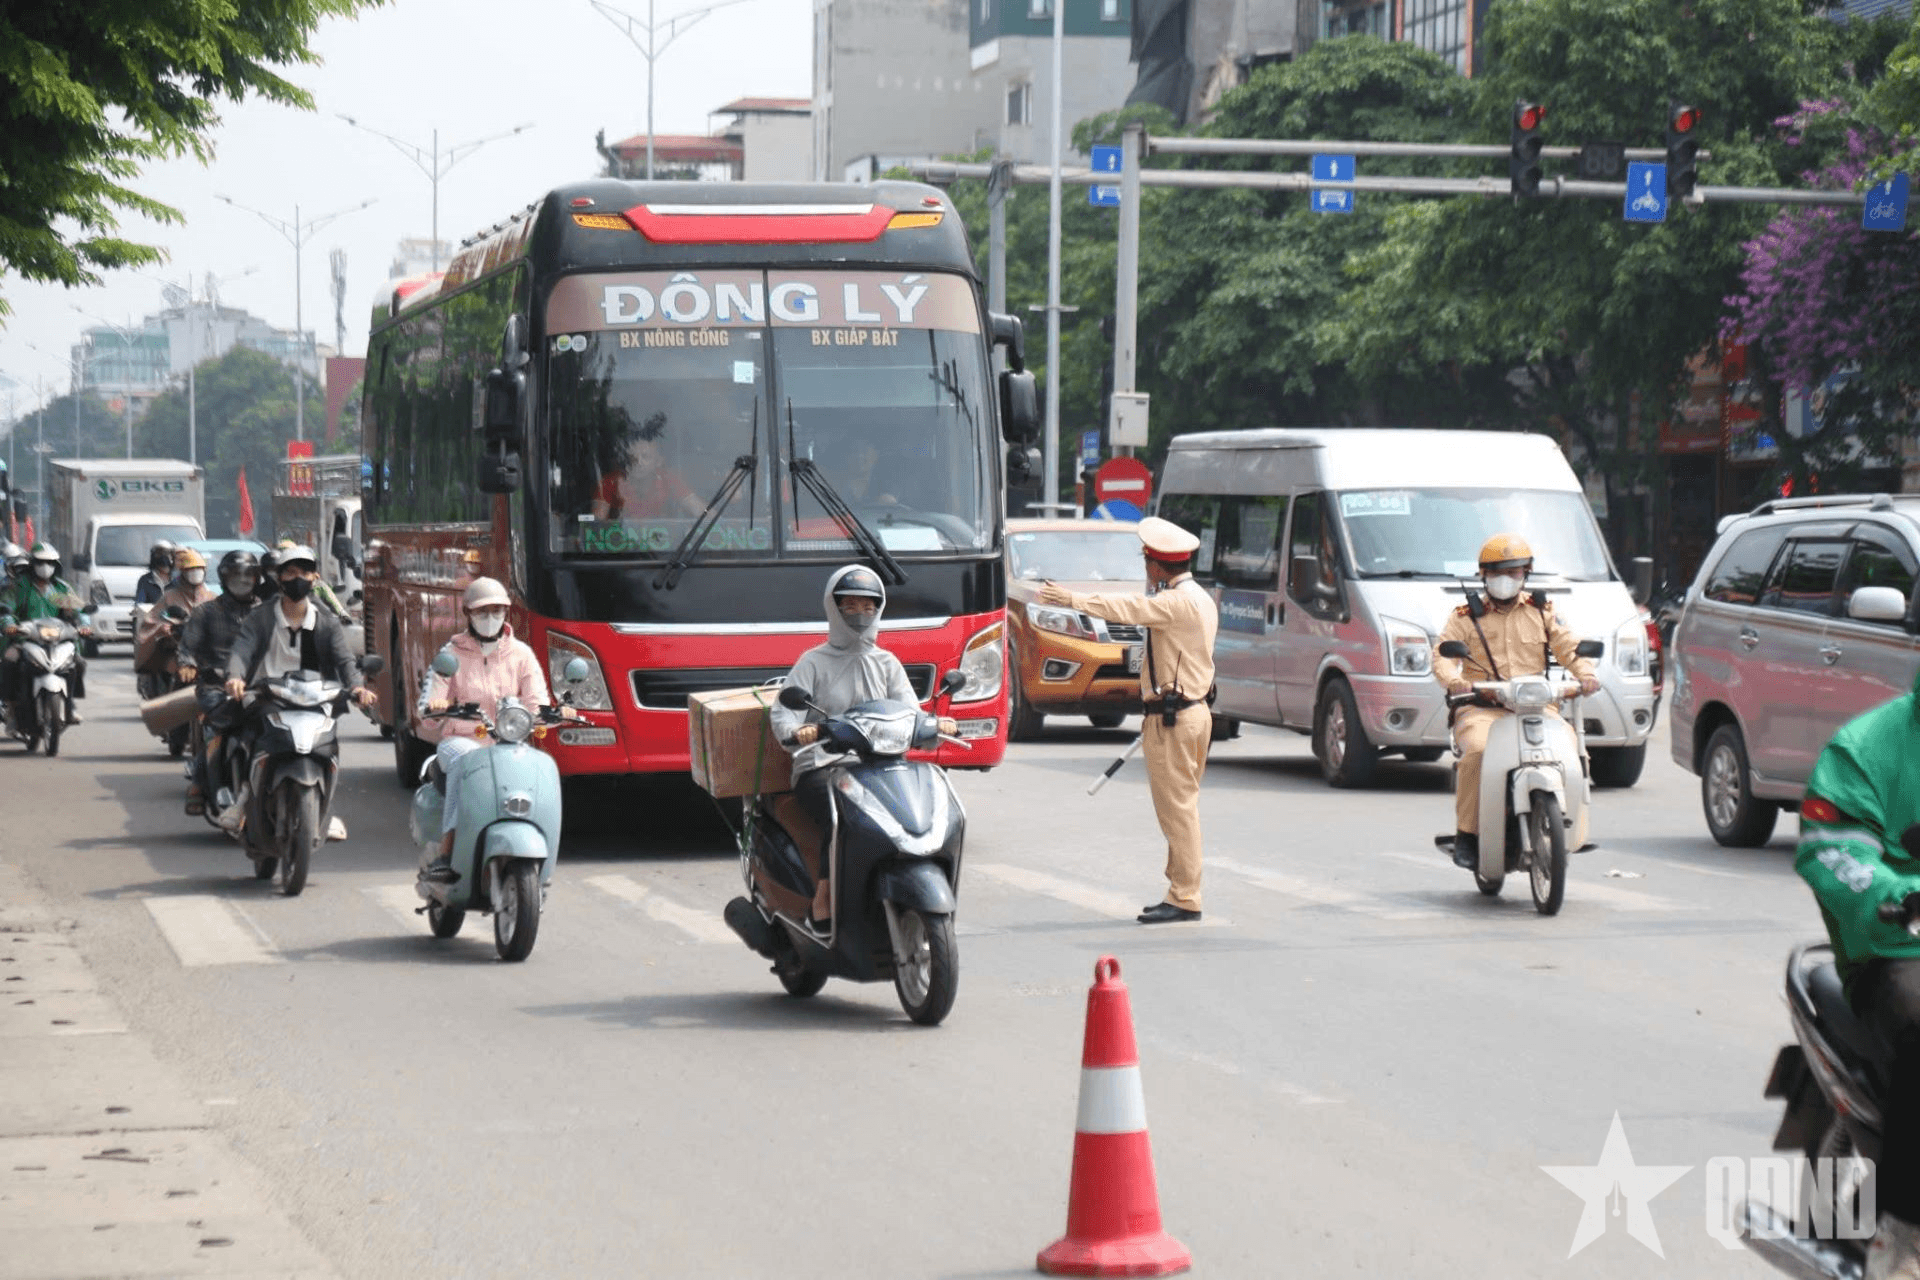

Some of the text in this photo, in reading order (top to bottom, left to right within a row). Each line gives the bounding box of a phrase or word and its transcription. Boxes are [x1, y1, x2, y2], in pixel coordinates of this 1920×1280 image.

[600, 271, 929, 323] ĐÔNG LÝ
[620, 331, 640, 348] BX
[644, 327, 685, 347] NÔNG
[812, 329, 830, 346] BX
[835, 326, 868, 346] GIÁP
[584, 522, 671, 551] NÔNG
